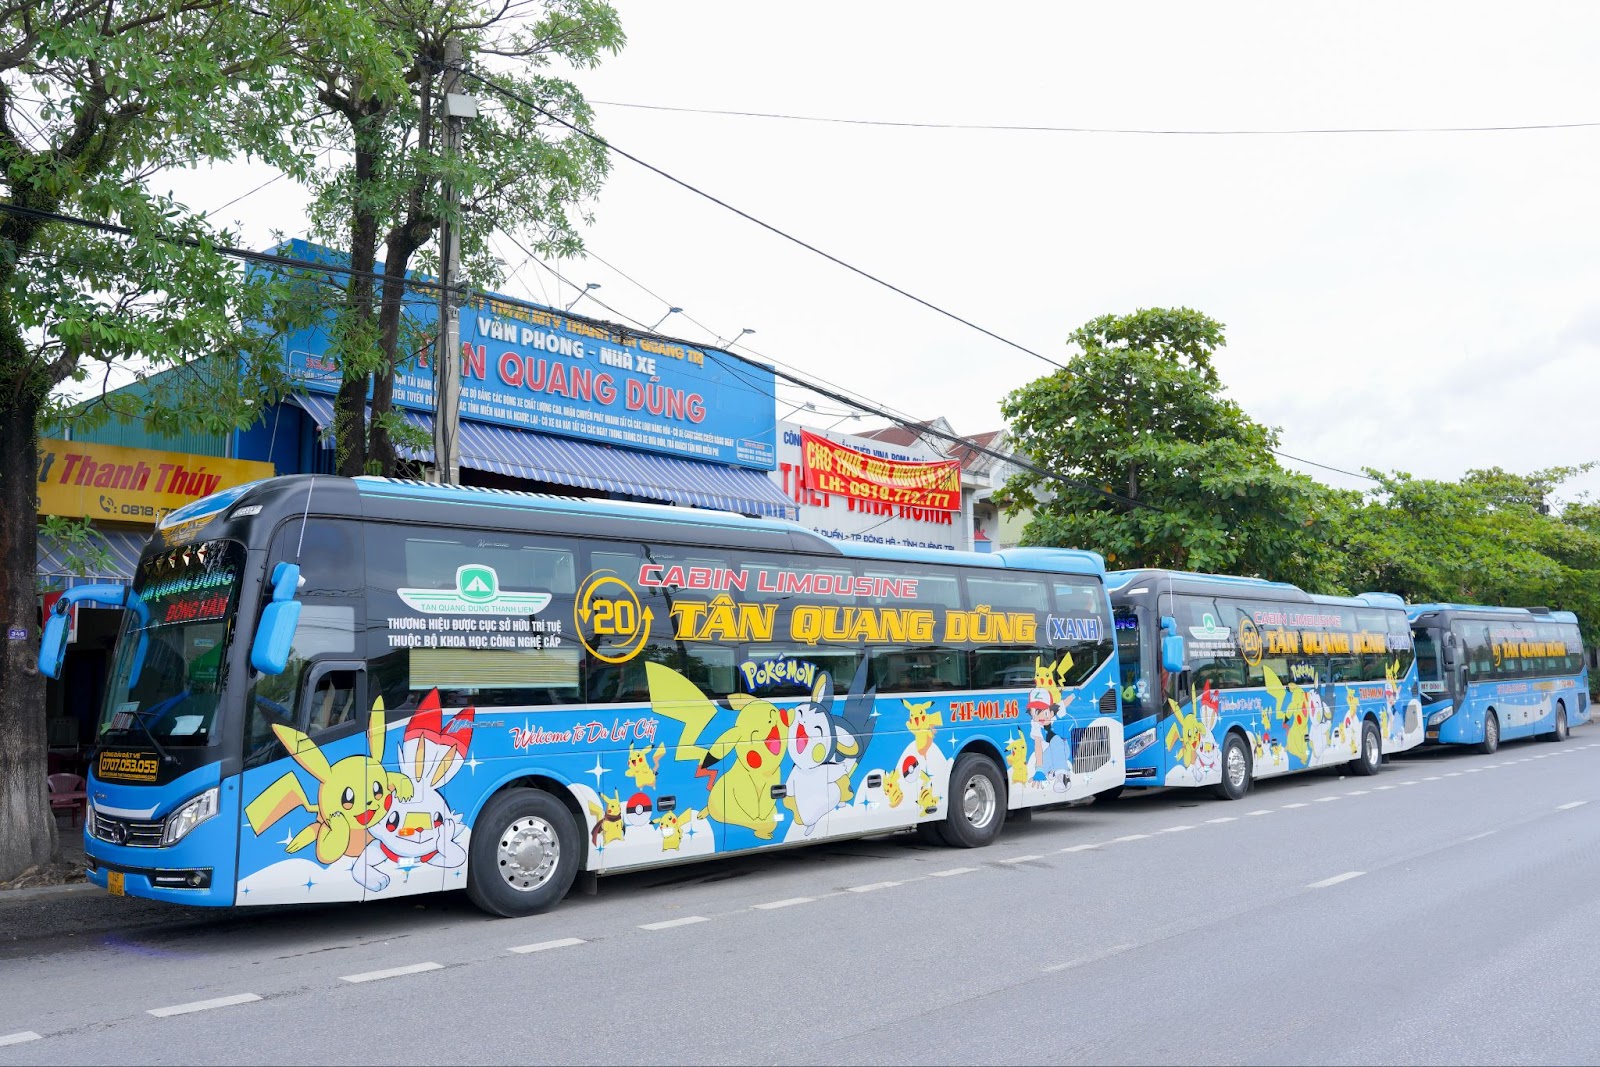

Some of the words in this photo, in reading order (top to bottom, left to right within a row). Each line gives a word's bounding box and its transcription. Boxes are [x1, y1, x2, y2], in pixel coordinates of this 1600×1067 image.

[477, 316, 518, 345] VĂN
[520, 329, 585, 360] PHÒNG
[599, 346, 634, 373] NHÀ
[634, 354, 657, 376] XE
[498, 351, 618, 406] QUANG
[624, 376, 707, 424] DŨNG
[806, 440, 832, 472] CHO
[59, 453, 152, 491] Thanh
[154, 465, 222, 497] Thúy
[819, 474, 845, 493] LH:
[885, 536, 896, 546] HÀ
[638, 563, 749, 591] CABIN
[757, 570, 919, 599] LIMOUSINE
[439, 604, 467, 613] QUANG
[491, 605, 517, 613] THANH
[593, 599, 636, 635] 20
[669, 593, 779, 642] TÂN
[790, 604, 937, 646] QUANG
[942, 604, 1038, 644] DŨNG
[1045, 613, 1104, 645] (XANH)
[1253, 611, 1287, 626] CABIN
[1289, 613, 1342, 628] LIMOUSINE
[387, 617, 427, 631] THƯƠNG
[428, 616, 450, 633] HIỆU
[452, 619, 478, 633] ĐƯỢC
[478, 620, 497, 634] CỤC
[499, 617, 511, 632] SỞ
[512, 619, 530, 632] HỮU
[532, 620, 546, 632] TRÍ
[546, 619, 562, 634] TUỆ
[388, 633, 422, 650] THUỘC
[424, 633, 438, 650] BỘ
[440, 636, 467, 647] KHOA
[468, 636, 488, 650] HỌC
[490, 633, 516, 648] CÔNG
[517, 635, 542, 650] NGHỆ
[543, 633, 562, 648] CẤP
[1265, 626, 1299, 654] TÂN
[1302, 632, 1351, 656] QUANG
[1352, 629, 1387, 654] DŨNG
[949, 700, 1019, 722] 74F-001.46
[509, 725, 572, 750] Welcome
[571, 722, 587, 745] to
[586, 722, 609, 744] Da
[611, 718, 634, 743] Lat
[633, 717, 660, 744] City
[102, 758, 157, 773] 0707.053.053
